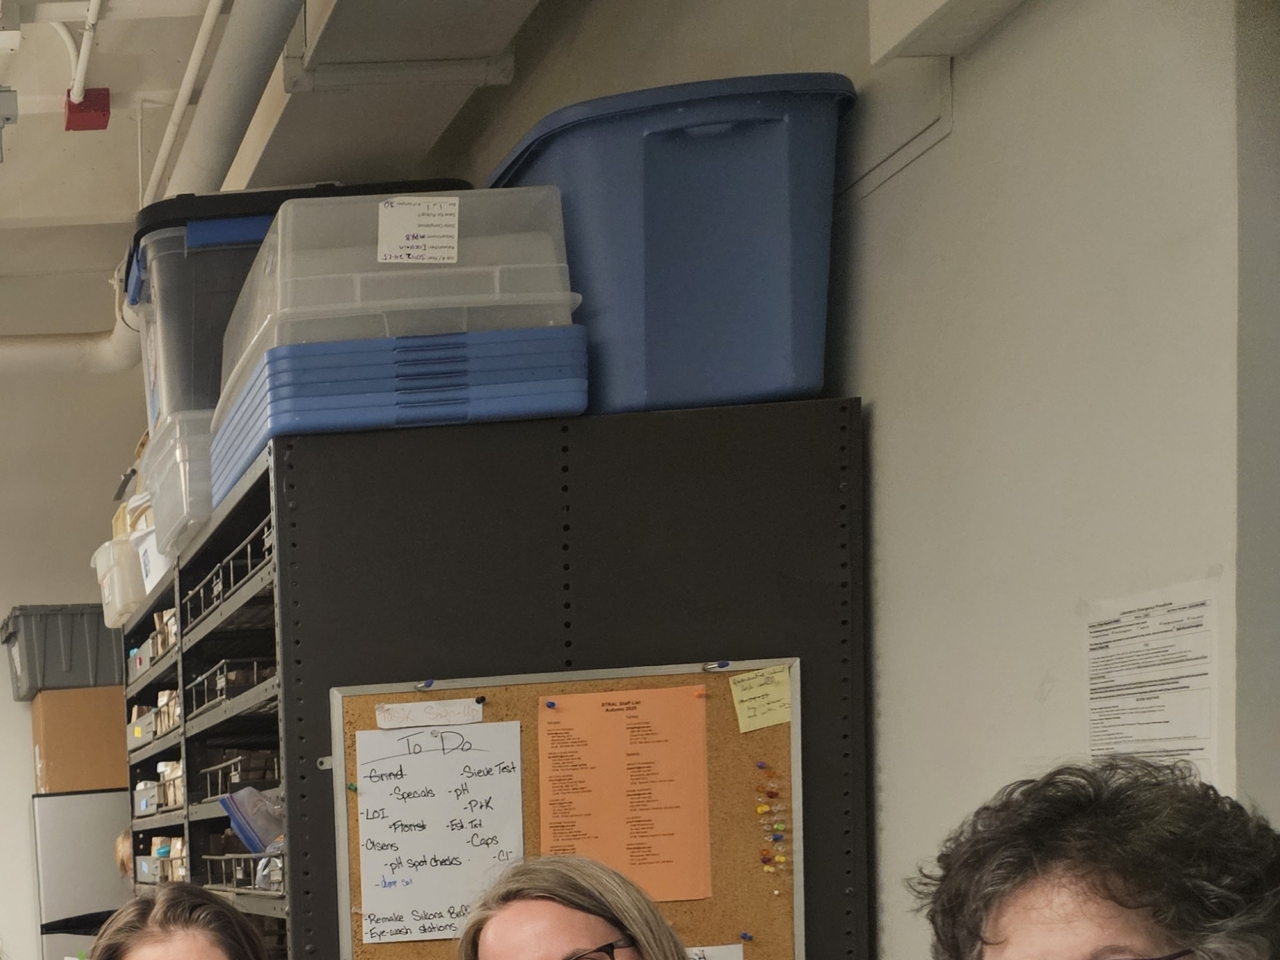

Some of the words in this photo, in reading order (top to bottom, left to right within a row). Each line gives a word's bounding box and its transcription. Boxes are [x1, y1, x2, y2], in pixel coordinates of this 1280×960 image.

[378, 708, 412, 722] Task
[397, 730, 424, 754] To
[440, 730, 472, 755] Do
[494, 761, 516, 774] Test
[406, 856, 428, 872] spot
[418, 922, 458, 934] stations
